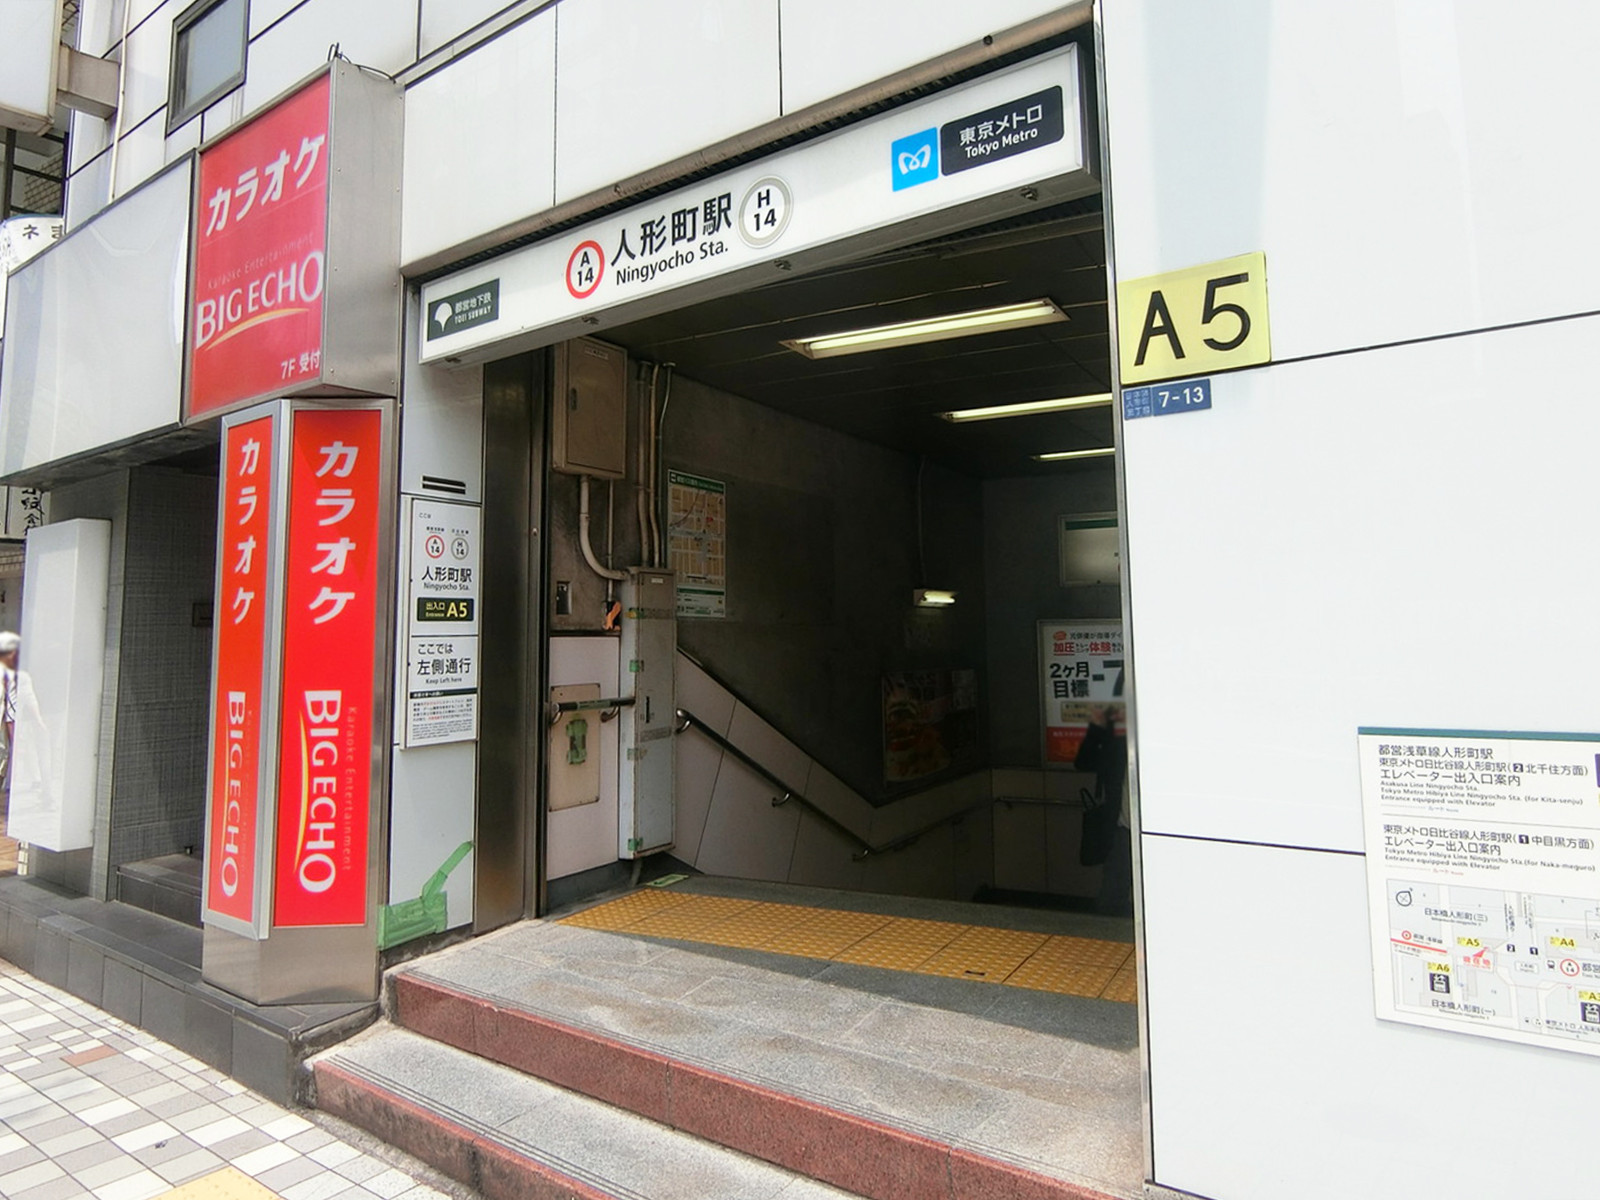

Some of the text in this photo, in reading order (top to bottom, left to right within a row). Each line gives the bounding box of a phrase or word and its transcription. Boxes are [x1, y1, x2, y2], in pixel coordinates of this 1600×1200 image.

[959, 104, 1043, 147] 東京メトロ
[965, 128, 1038, 159] Tokyo Metro
[206, 134, 325, 237] カラオケ
[757, 189, 771, 209] H
[611, 192, 732, 267] 人形町駅
[754, 208, 777, 232] 14
[580, 251, 591, 267] A
[616, 240, 729, 286] Ningyocho Sta.
[576, 267, 594, 287] 14
[196, 250, 325, 350] BIG ECHO
[1134, 272, 1251, 366] A5
[281, 349, 321, 380] 7F 受付
[1158, 386, 1204, 408] 7-13
[232, 437, 260, 625] カラオケ
[308, 440, 359, 625] カラオケ
[430, 545, 440, 554] 14
[455, 547, 464, 555] 14
[421, 566, 472, 583] 人形町駅
[423, 582, 458, 592] Ningyocho
[446, 602, 468, 618] A5
[417, 643, 453, 655] ここでは
[417, 658, 472, 676] 左側通行
[1049, 661, 1090, 679] 2ヶ月
[1053, 679, 1090, 699] 目標
[1378, 744, 1494, 760] 都営浅草線人形町駅
[1380, 769, 1521, 787] エレベーター出入口案内
[221, 691, 246, 897] BIG ECHO
[299, 689, 342, 893] BIG ECHO
[342, 706, 358, 871] Karaoke Entertainment
[1381, 787, 1401, 795] Tokyo
[1381, 794, 1496, 807] Entrance equipped with Elevator
[1384, 836, 1502, 856] エレベーター出入口案内
[1385, 847, 1405, 855] Tokyo
[1406, 849, 1428, 857] Metro
[1385, 855, 1415, 863] Entrance
[1416, 858, 1450, 866] equipped
[1469, 862, 1500, 870] Elevator
[1466, 938, 1480, 947] A5
[1560, 938, 1575, 947] A4
[1436, 963, 1450, 972] A6
